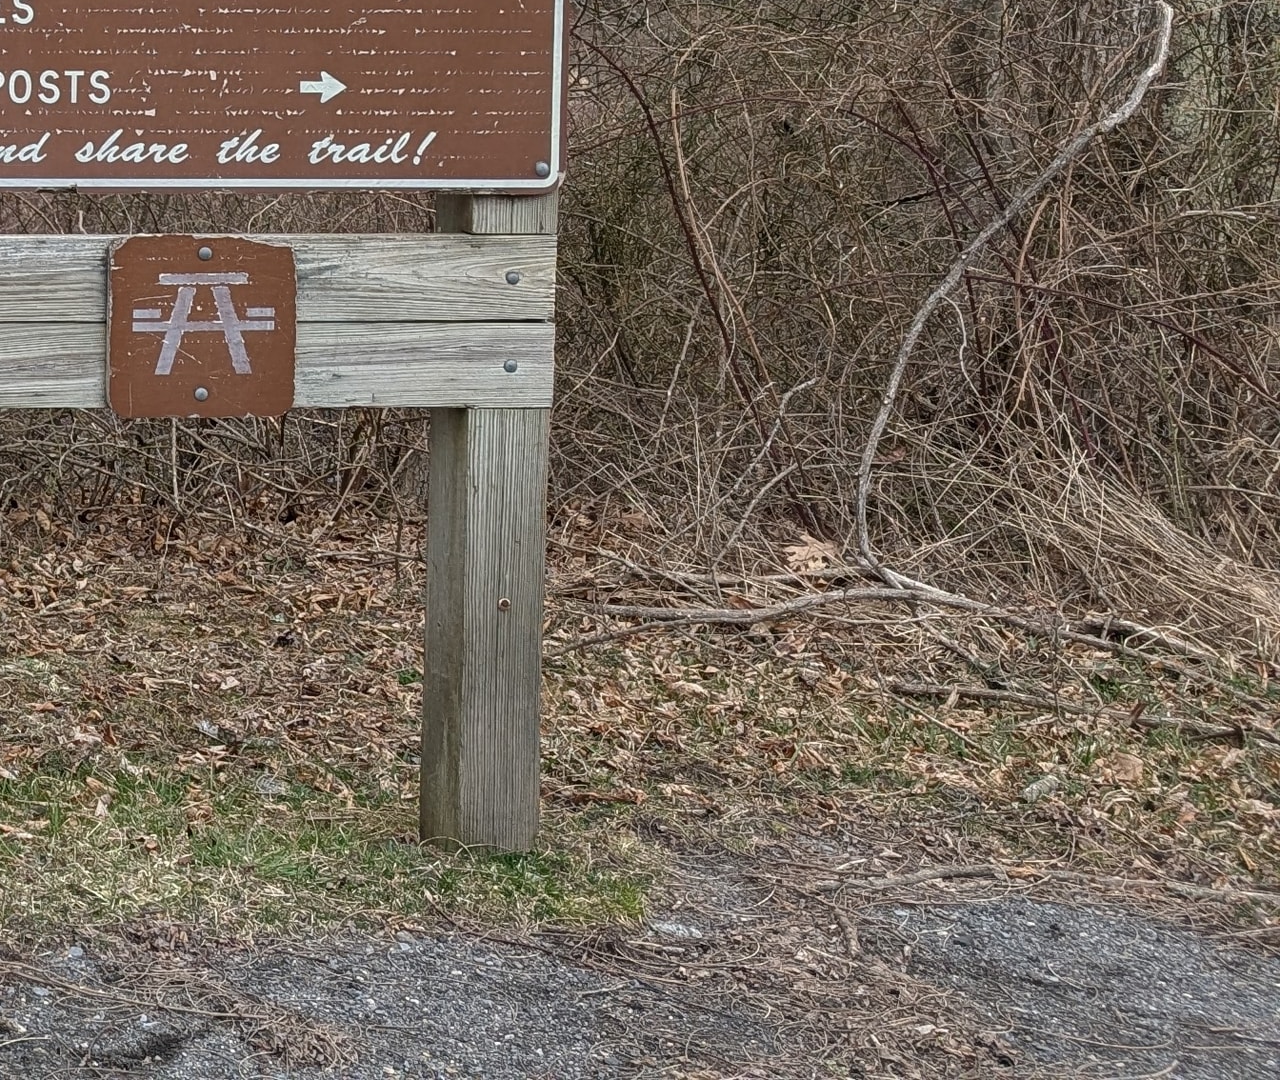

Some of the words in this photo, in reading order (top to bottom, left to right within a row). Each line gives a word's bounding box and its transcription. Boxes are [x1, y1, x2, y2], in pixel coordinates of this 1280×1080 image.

[74, 128, 190, 165] share
[215, 128, 281, 165] the
[307, 131, 438, 166] trail!
